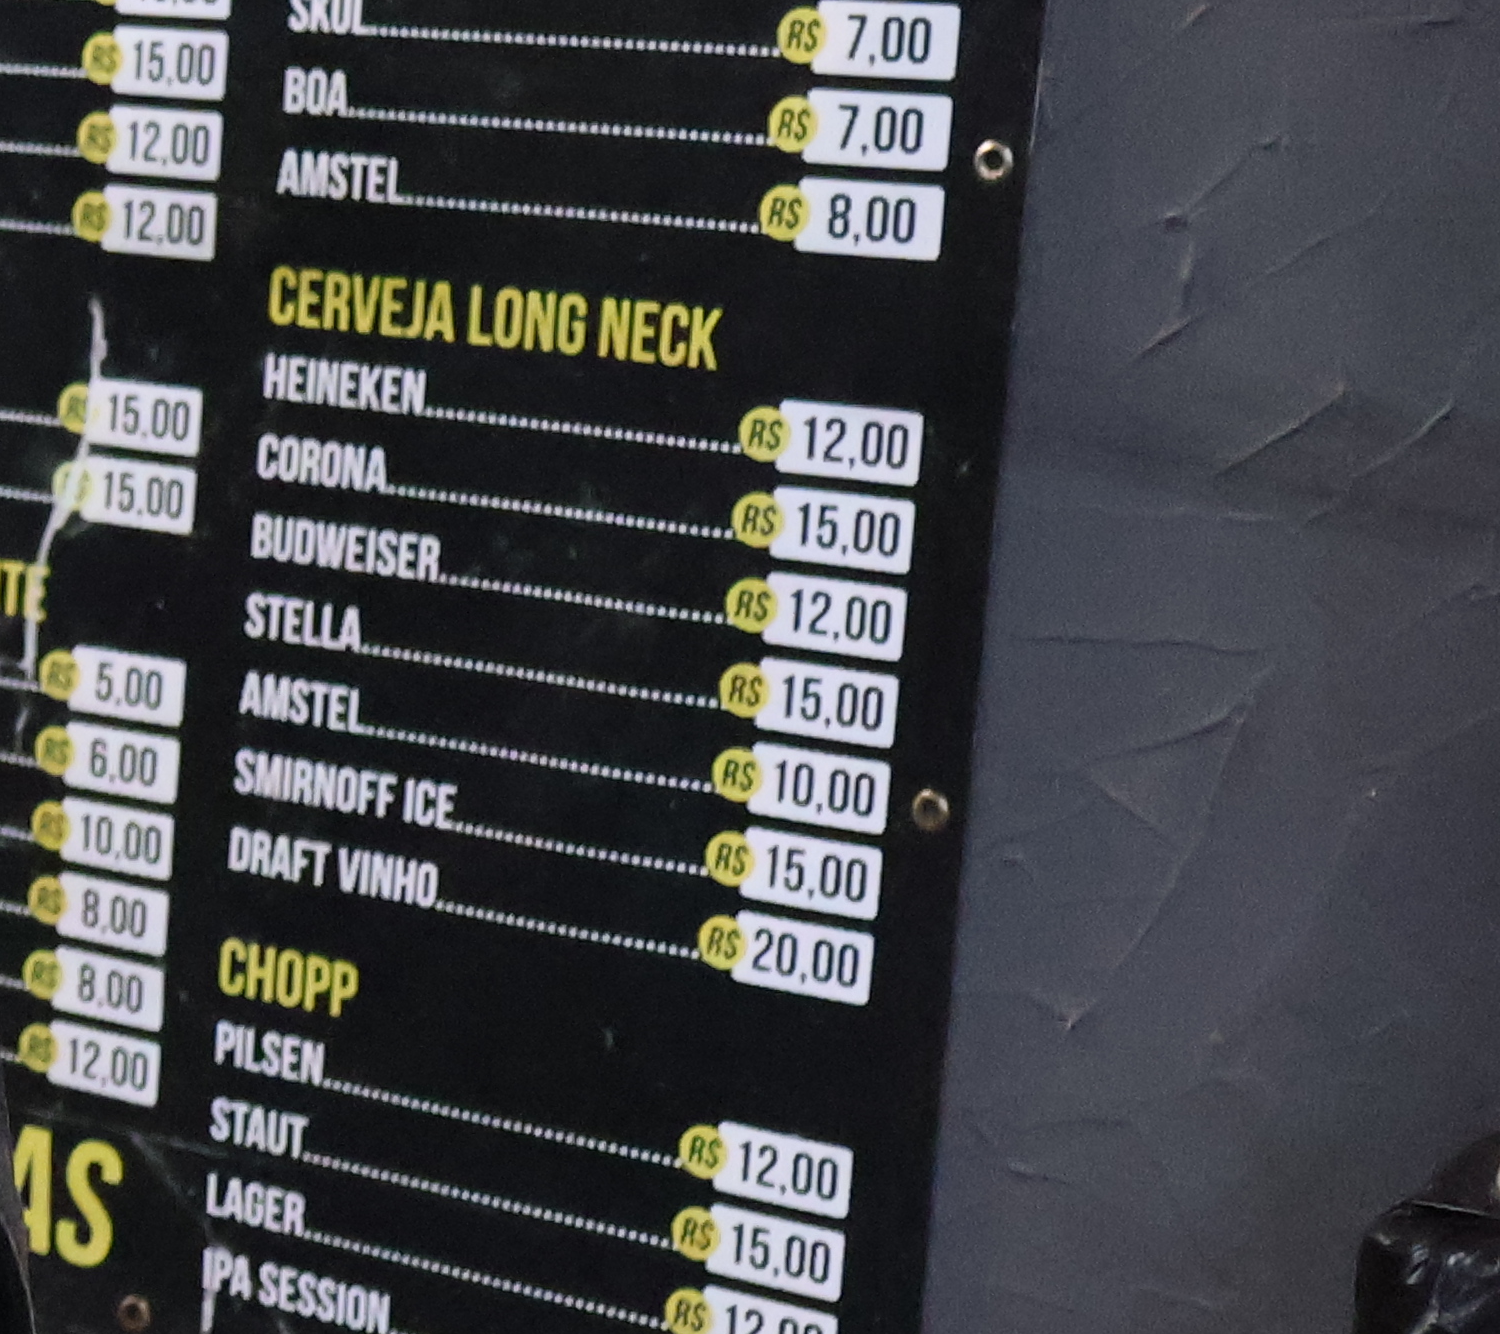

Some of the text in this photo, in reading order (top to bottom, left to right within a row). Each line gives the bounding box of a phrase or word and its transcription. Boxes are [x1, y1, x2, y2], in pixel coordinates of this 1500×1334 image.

[134, 40, 217, 87] 15,00
[846, 14, 933, 67] 7,00
[128, 120, 211, 168] 12,00
[283, 66, 348, 118] BOA
[837, 104, 925, 157] 7,00
[123, 199, 206, 247] 12,00
[277, 150, 405, 205] AMSTEL
[827, 193, 918, 247] 8,00
[268, 265, 723, 371] CERVEJA LONG NECK
[263, 354, 425, 415] HEINEKEN
[803, 415, 910, 471] 12,00
[257, 434, 388, 493] CORONA
[797, 501, 902, 559] 15,00
[251, 513, 441, 582] BUDWEISER
[789, 588, 893, 646] 12,00
[95, 661, 164, 711] 5,00
[245, 593, 363, 652] STELLA
[782, 673, 885, 732] 15,00
[89, 737, 159, 788] 6,00
[239, 671, 364, 734] AMSTEL
[775, 759, 877, 819] 10,00
[78, 813, 163, 865] 10,00
[234, 753, 397, 821] SMIRNOFF
[404, 777, 457, 831] ICE
[767, 844, 869, 904] 15,00
[80, 887, 148, 940] 8,00
[229, 827, 328, 885] DRAFT
[338, 850, 439, 909] VINHO
[753, 927, 861, 989] 20,00
[77, 962, 144, 1015] 8,00
[219, 939, 359, 1018] CHOPP
[67, 1037, 149, 1092] 12,00
[215, 1020, 325, 1086] PILSEN
[739, 1141, 839, 1202] 12,00
[207, 1174, 306, 1234] LAGER
[210, 1098, 309, 1158] STAUT
[732, 1222, 832, 1286] 15,00
[202, 1247, 252, 1299] IPA
